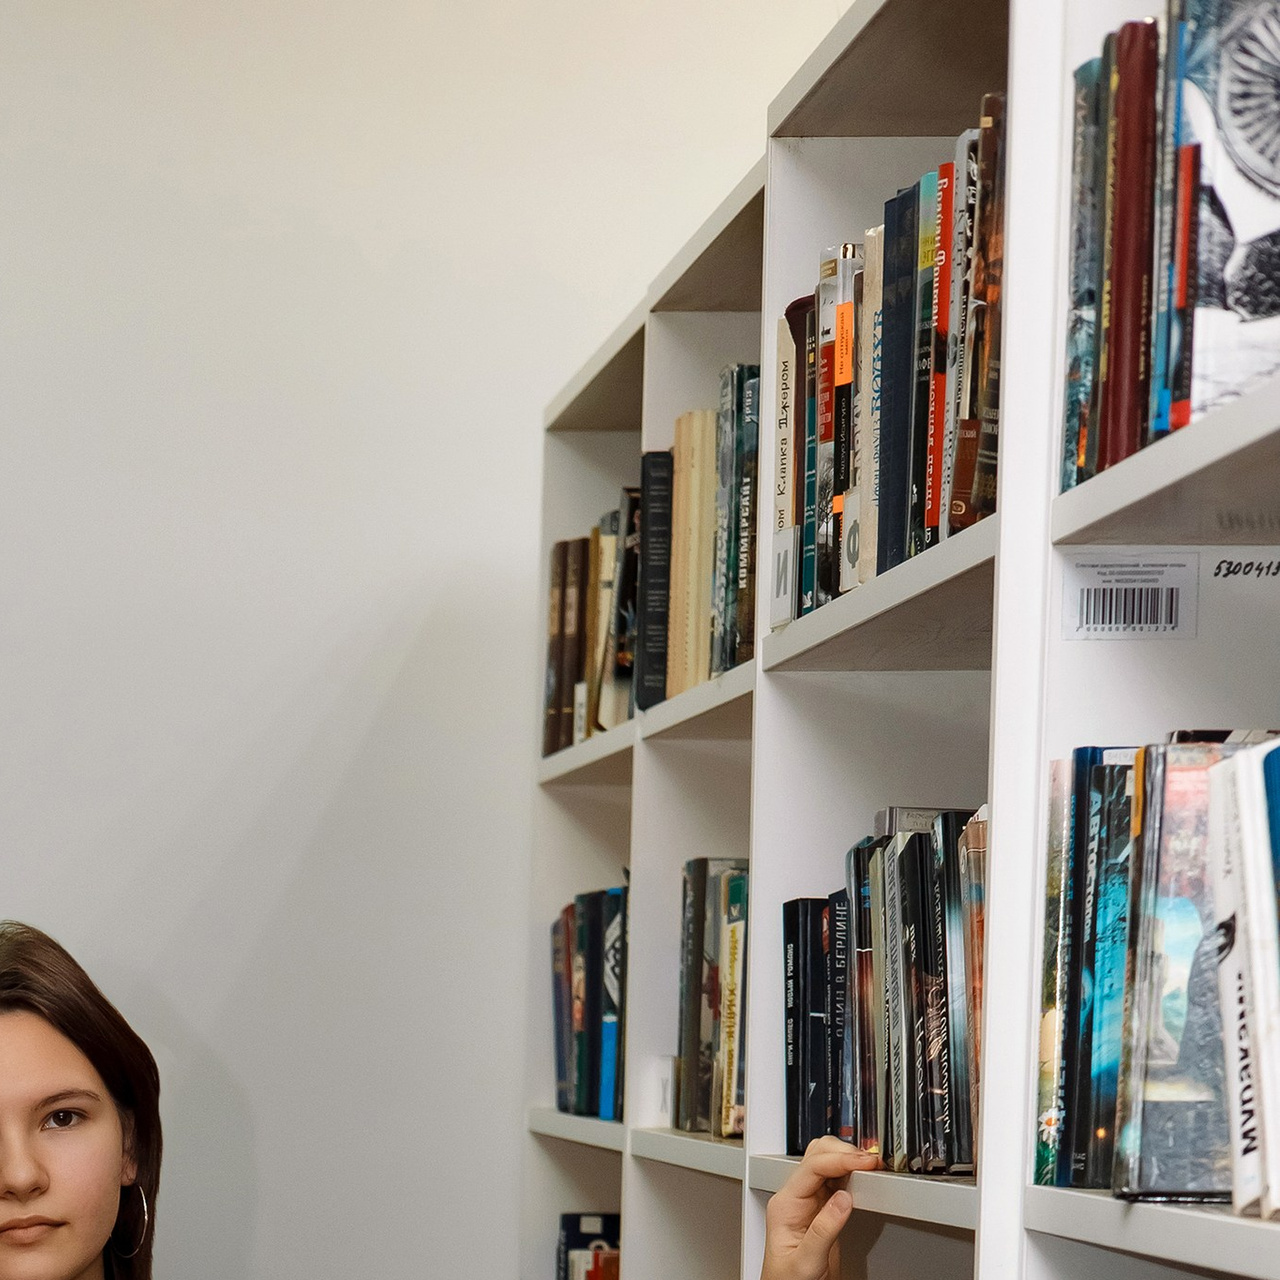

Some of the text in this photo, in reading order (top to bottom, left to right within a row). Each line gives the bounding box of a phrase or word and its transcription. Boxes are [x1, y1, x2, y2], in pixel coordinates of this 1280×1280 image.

[777, 360, 789, 496] Клапка Джером
[847, 519, 859, 569] Ф
[775, 550, 788, 598] И
[835, 901, 847, 968] БЕРЛИНЕ
